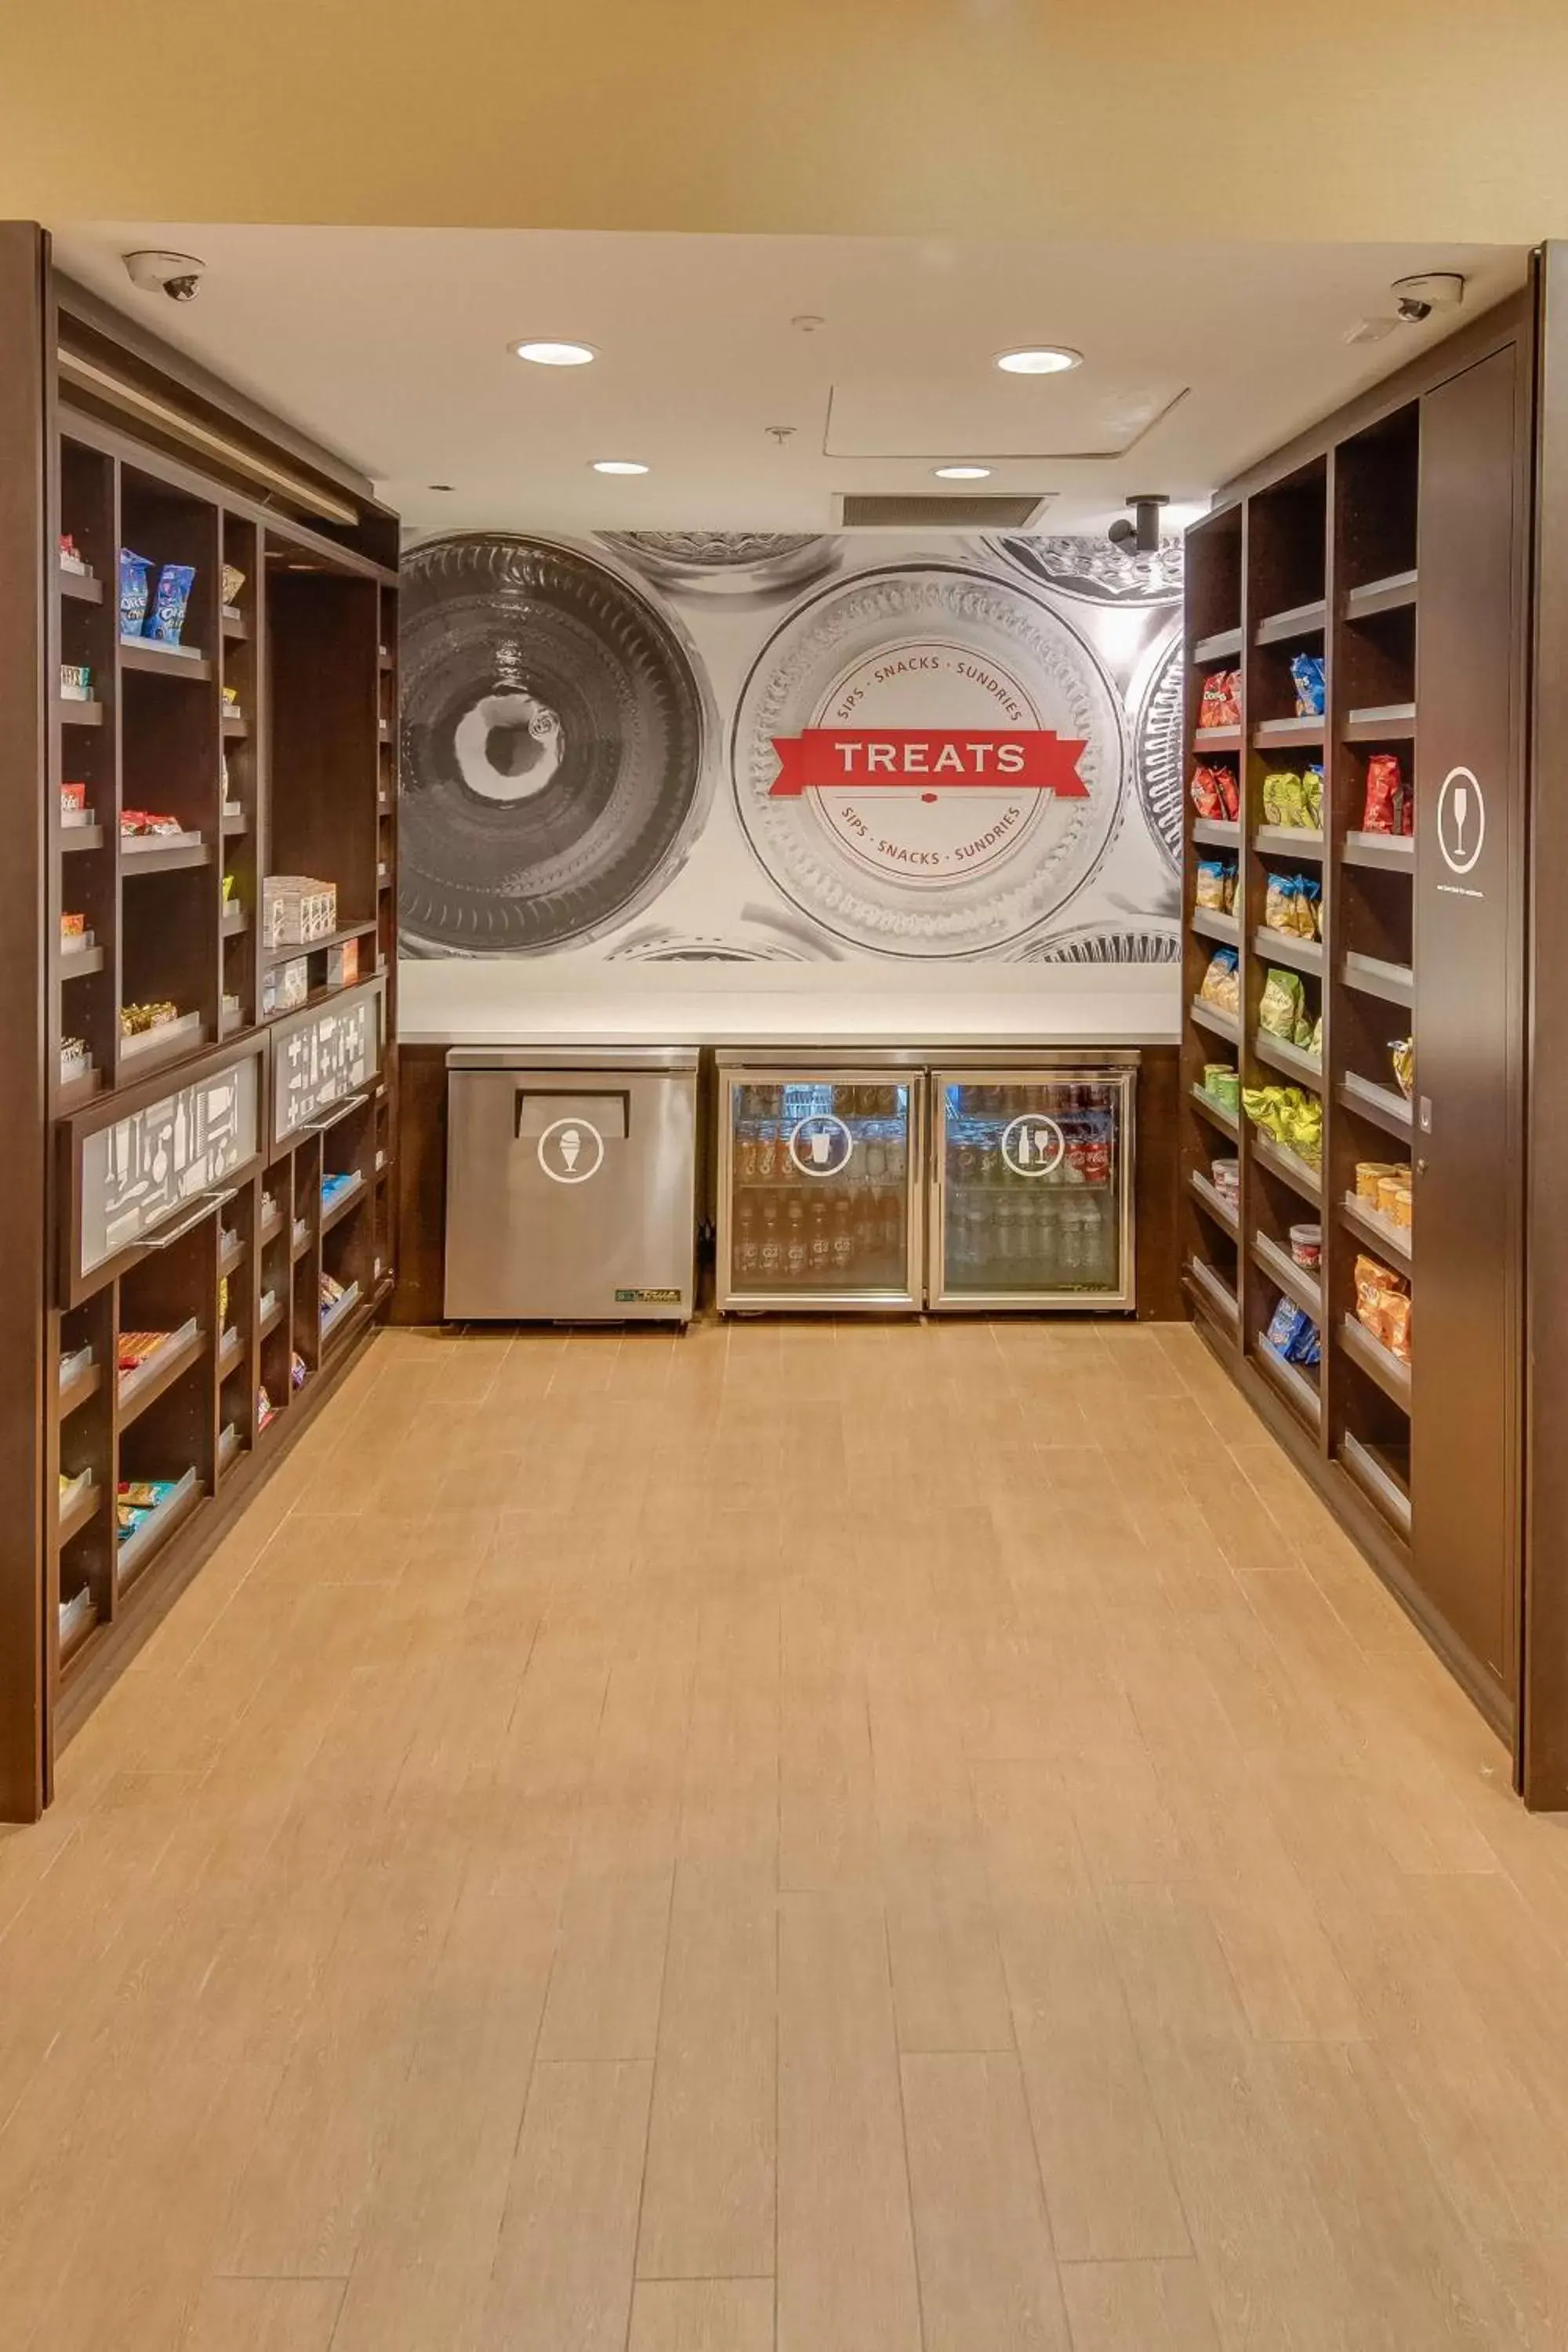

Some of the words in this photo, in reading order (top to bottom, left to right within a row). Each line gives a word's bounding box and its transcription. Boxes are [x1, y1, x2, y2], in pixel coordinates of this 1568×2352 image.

[837, 688, 864, 720] SIPS
[874, 657, 939, 683] SNACKS
[956, 662, 1022, 722] SUNDRIES
[833, 743, 1025, 773] TREATS
[841, 807, 868, 836] SIPS
[878, 840, 939, 865] SNACKS
[954, 807, 1021, 860] SUNDRIES
